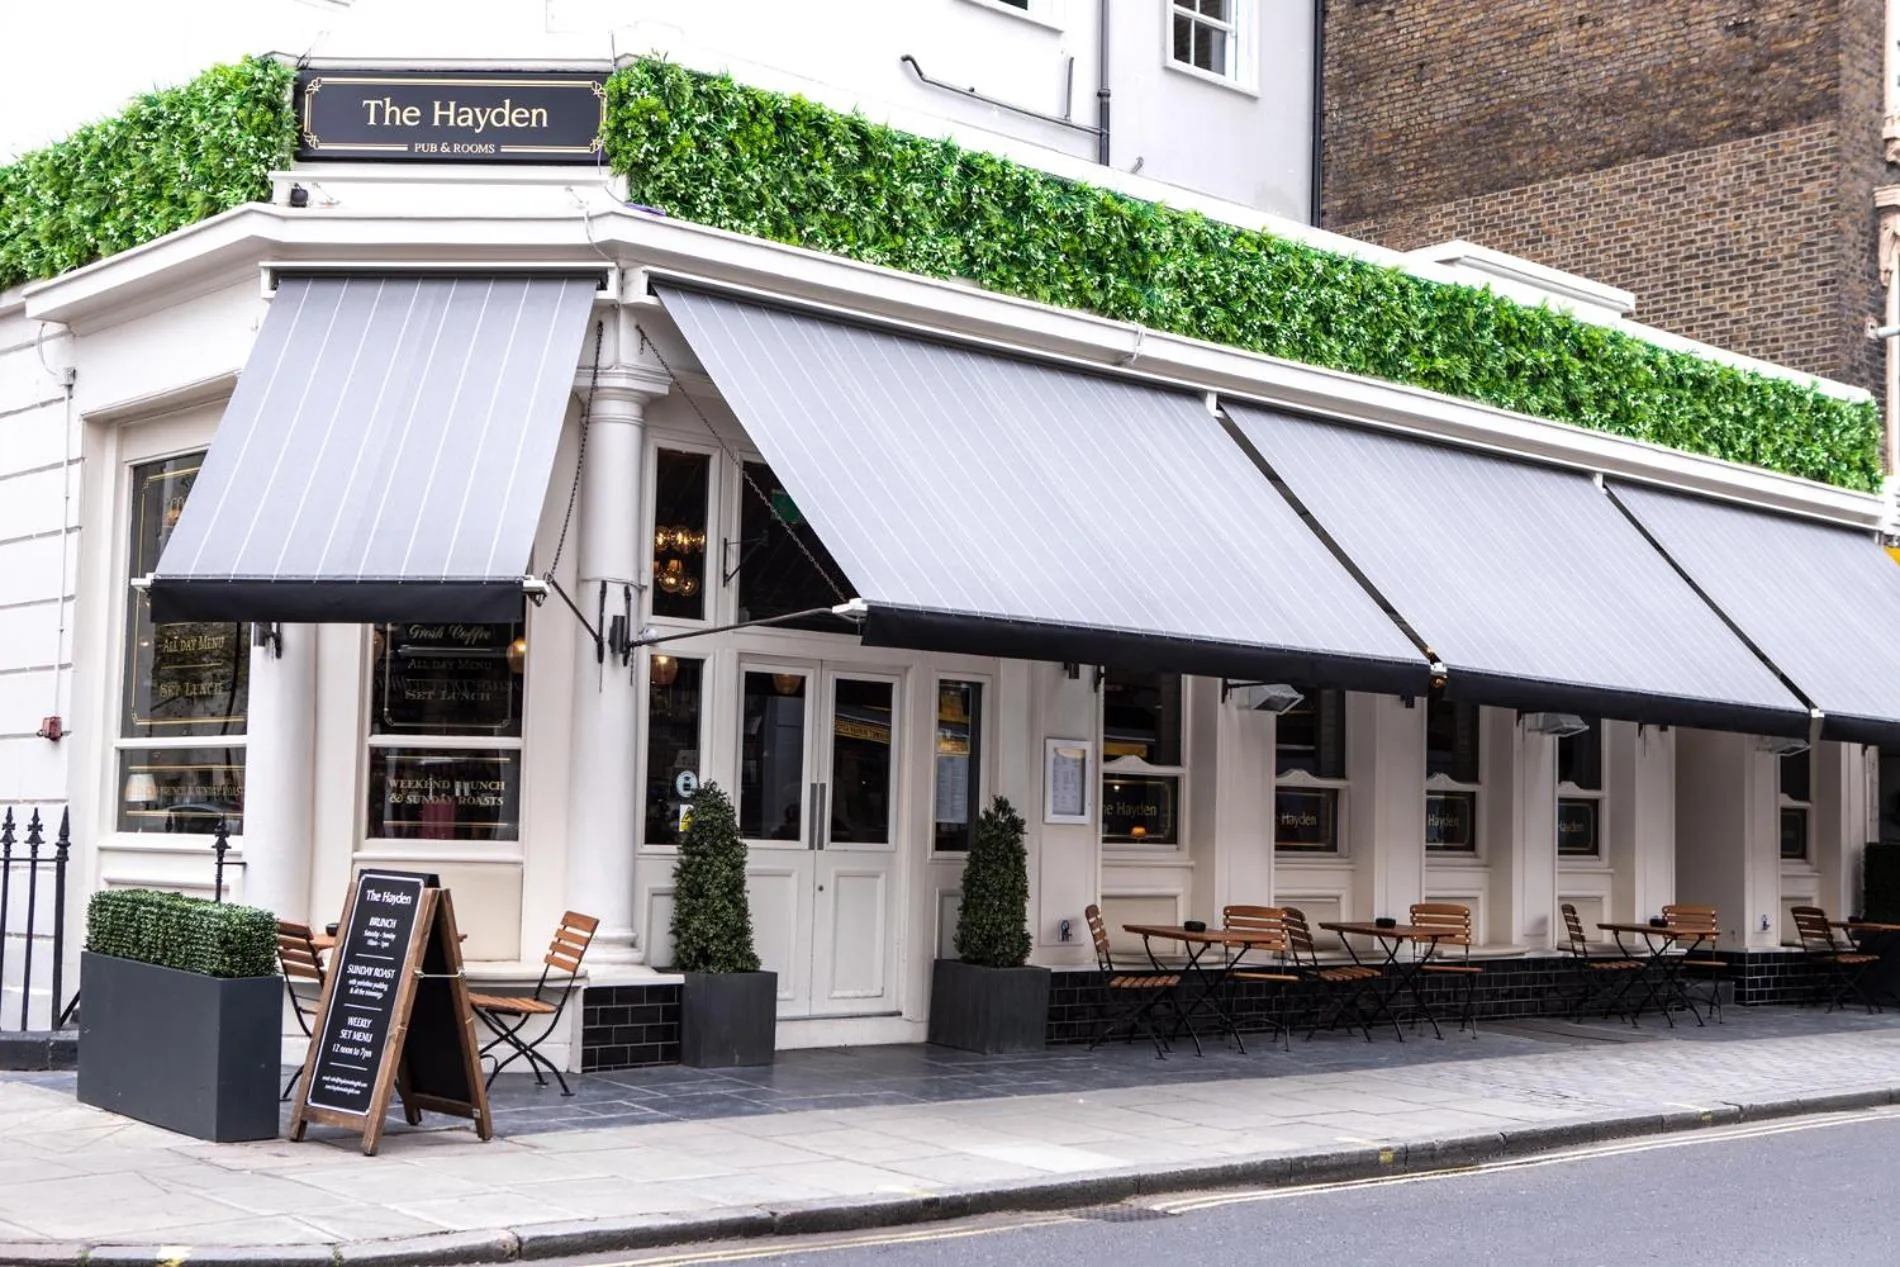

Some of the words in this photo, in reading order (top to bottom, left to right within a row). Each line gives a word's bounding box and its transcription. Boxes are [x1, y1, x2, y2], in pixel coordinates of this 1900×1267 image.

[362, 98, 420, 126] The
[433, 99, 548, 133] Hayden
[414, 143, 437, 153] PUB
[440, 143, 450, 153] &
[453, 143, 496, 154] ROOMS
[389, 778, 450, 789] WEEKEND
[389, 793, 402, 803] &
[406, 795, 454, 805] SUNDAY
[457, 796, 504, 806] ROASTS
[1117, 801, 1157, 818] Hayden
[1281, 811, 1317, 828] Hayden
[366, 889, 381, 901] The
[382, 890, 412, 905] Hayden
[369, 917, 397, 928] BRUNCH
[347, 964, 374, 976] SUNDAY
[373, 967, 396, 979] ROAST
[347, 1016, 373, 1028] WEEKLY
[339, 1029, 353, 1040] SET
[352, 1030, 373, 1042] MENU
